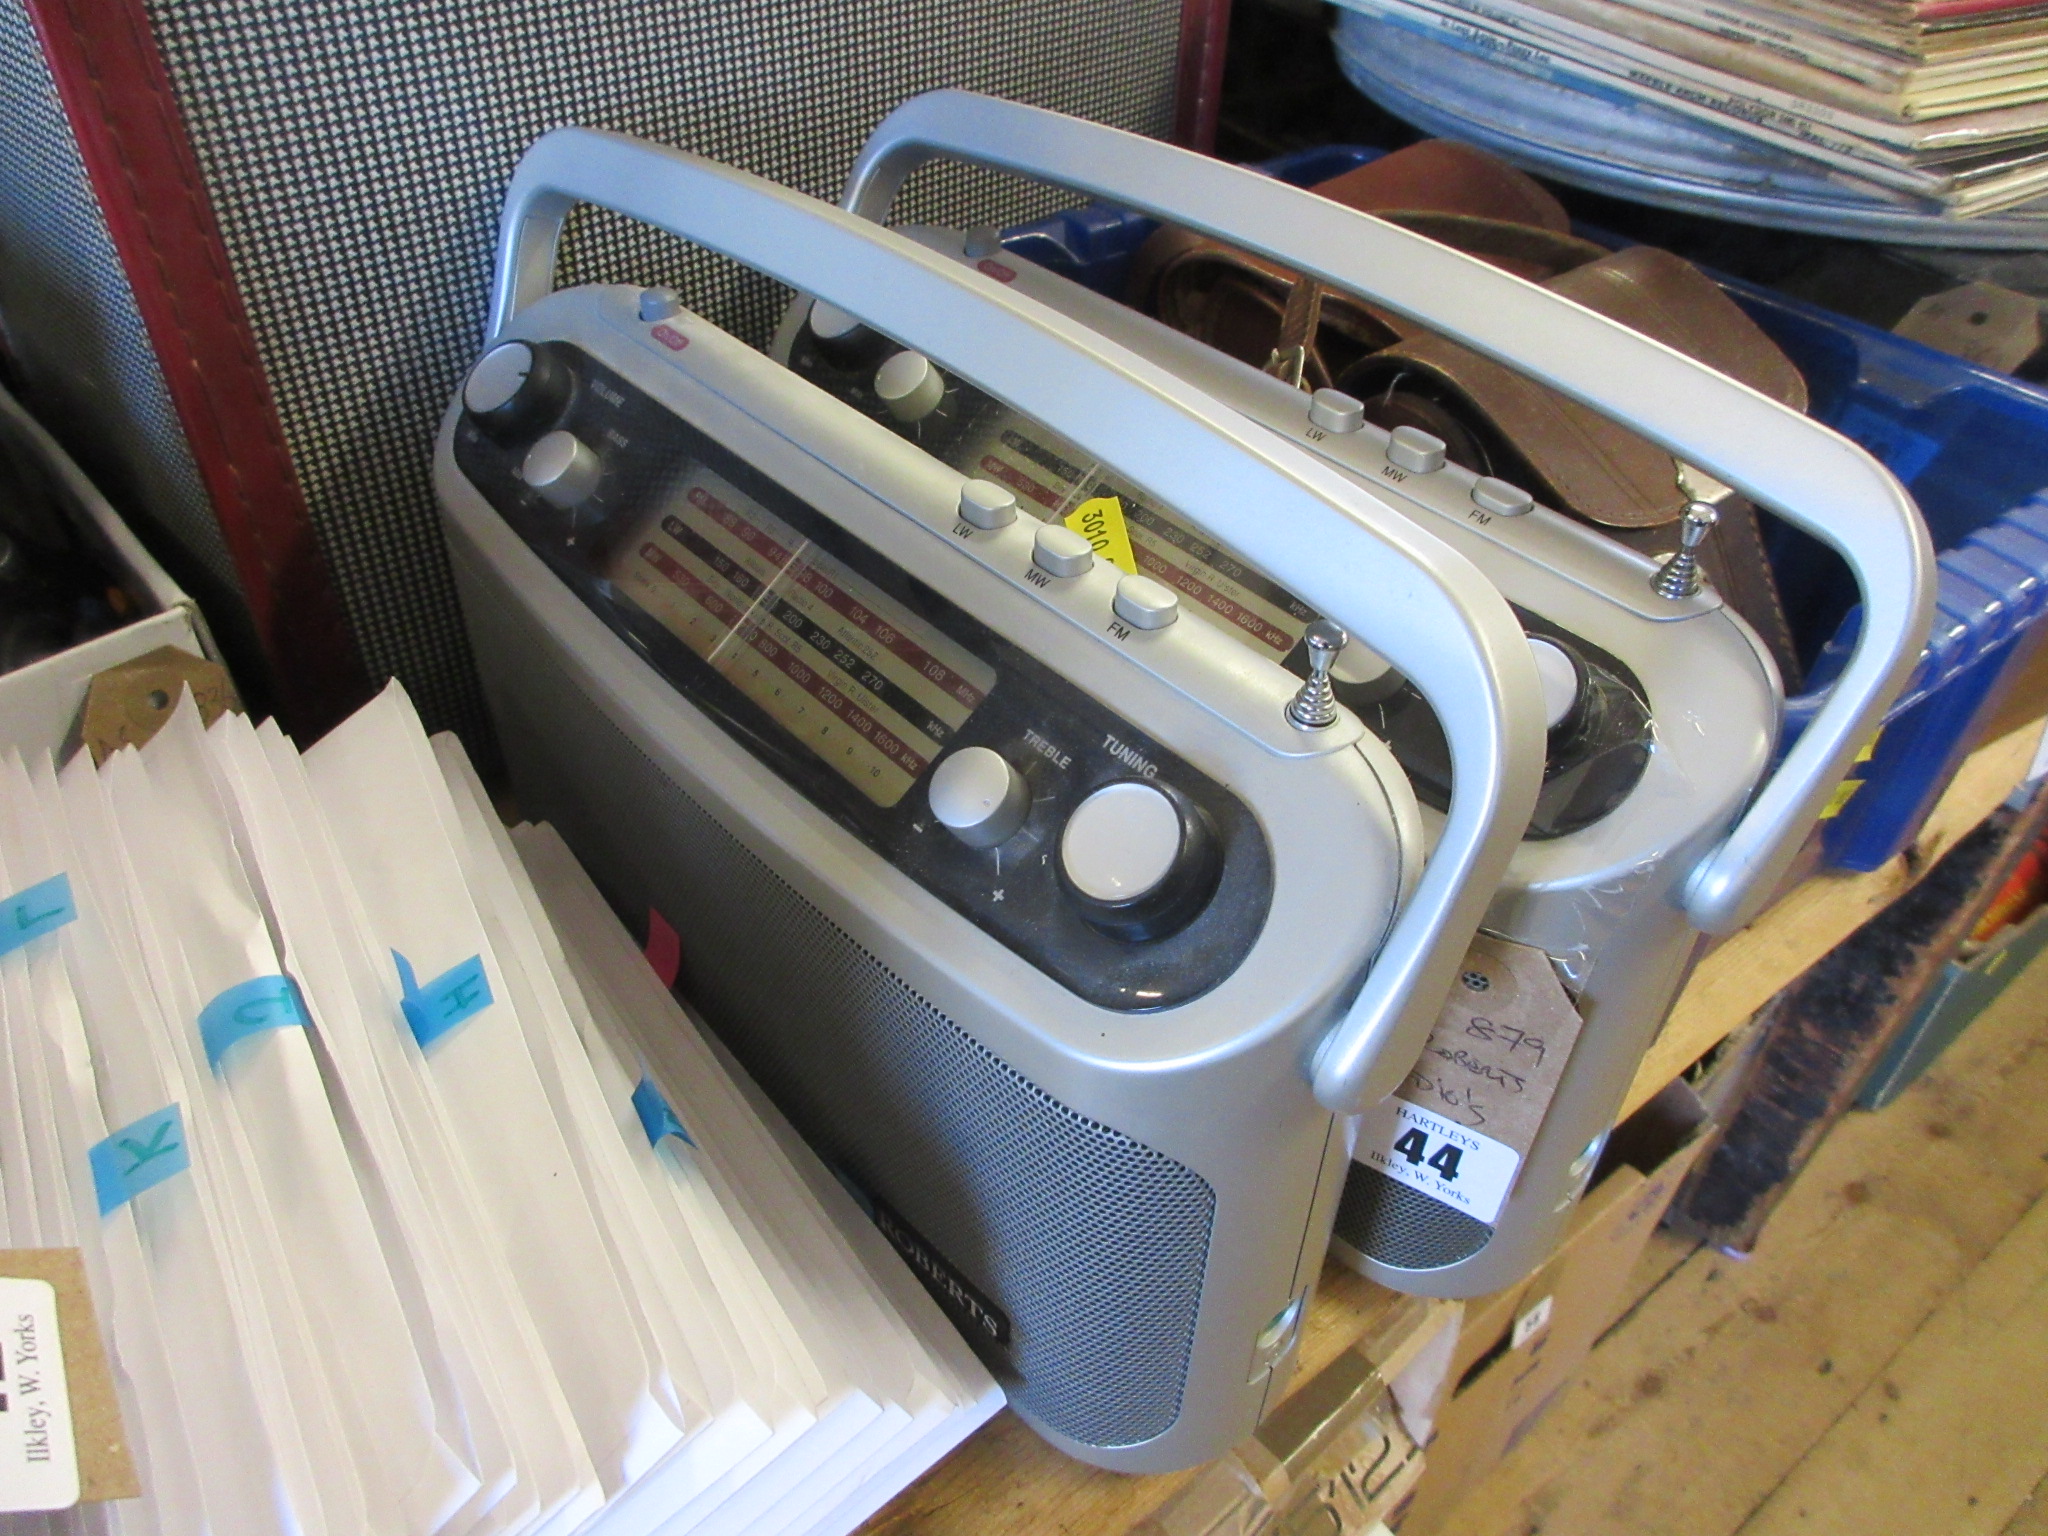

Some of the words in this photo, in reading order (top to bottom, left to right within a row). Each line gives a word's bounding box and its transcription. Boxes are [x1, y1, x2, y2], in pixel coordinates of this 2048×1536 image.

[1306, 427, 1327, 443] LW
[1381, 466, 1408, 482] MW
[952, 523, 974, 541] LW
[1081, 509, 1110, 553] 3010
[1468, 509, 1492, 526] FM
[1025, 568, 1051, 590] MW
[1219, 560, 1242, 577] 270
[815, 580, 834, 599] 100
[850, 605, 869, 626] 104
[875, 624, 895, 644] 106
[923, 660, 946, 682] 108
[1107, 622, 1130, 642] FM
[1177, 575, 1203, 595] 1200
[1207, 594, 1234, 614] 1400
[1237, 612, 1263, 632] 1600
[1265, 629, 1283, 646] kHz
[783, 609, 804, 630] 200
[810, 631, 832, 651] 230
[834, 650, 856, 670] 252
[861, 671, 884, 691] 270
[927, 719, 946, 739] kHz
[758, 638, 779, 657] 800
[788, 661, 811, 684] 1000
[818, 686, 843, 710] 1200
[847, 709, 872, 733] 1400
[874, 730, 900, 755] 1600
[901, 753, 919, 772] kHz
[1022, 728, 1073, 771] TREBLE
[1102, 733, 1159, 779] TUNING
[1394, 1104, 1481, 1152] HARTLEYS
[1393, 1126, 1465, 1182] 44
[1370, 1149, 1411, 1178] Ilkley,
[1413, 1168, 1432, 1187] W.
[1434, 1179, 1471, 1206] Yorks
[14, 1312, 39, 1366] Yorks
[18, 1369, 41, 1397] W.
[23, 1399, 53, 1465] Ilkley,
